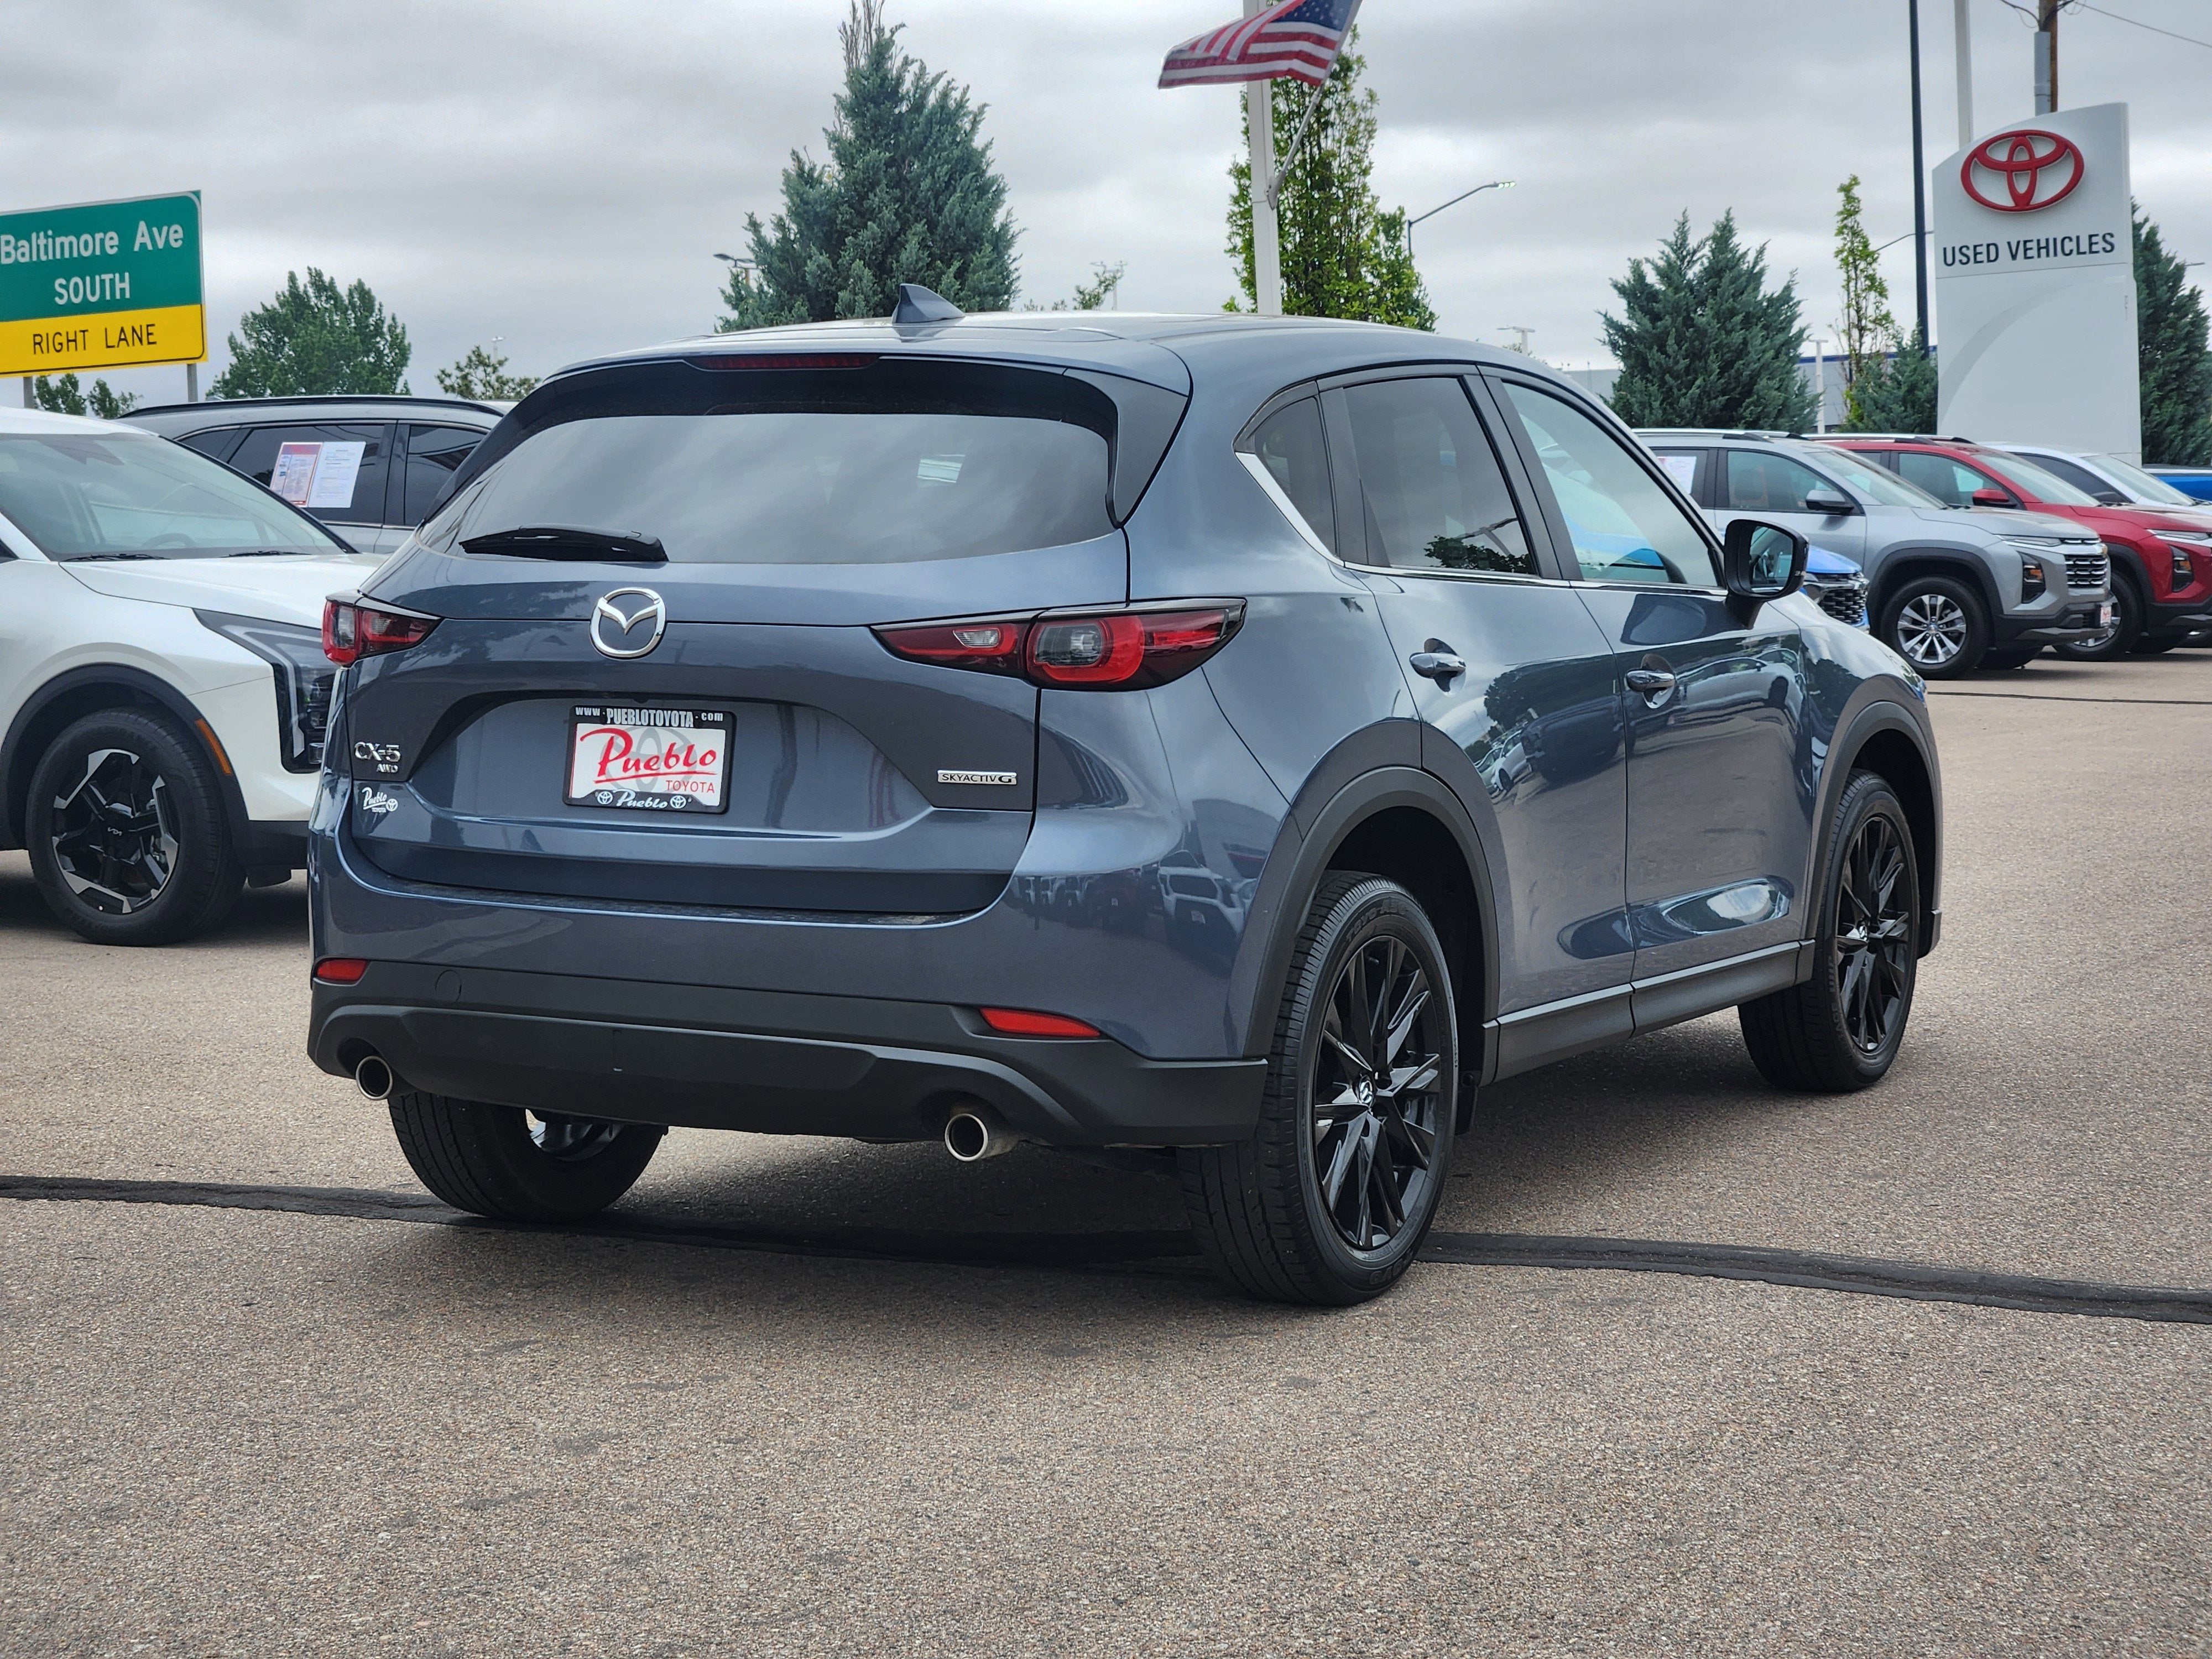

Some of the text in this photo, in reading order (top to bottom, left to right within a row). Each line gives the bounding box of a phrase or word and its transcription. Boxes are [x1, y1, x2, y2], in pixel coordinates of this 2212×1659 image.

[1, 221, 184, 264] Baltimore Ave
[1943, 232, 2116, 267] USED VEHICLES
[54, 272, 131, 305] SOUTH
[33, 324, 157, 354] RIGHT LANE
[354, 742, 401, 762] CX-5
[580, 727, 717, 777] Pueblo
[376, 764, 399, 773] AWD
[613, 789, 667, 809] Pueblo
[666, 780, 715, 794] TOYOTA
